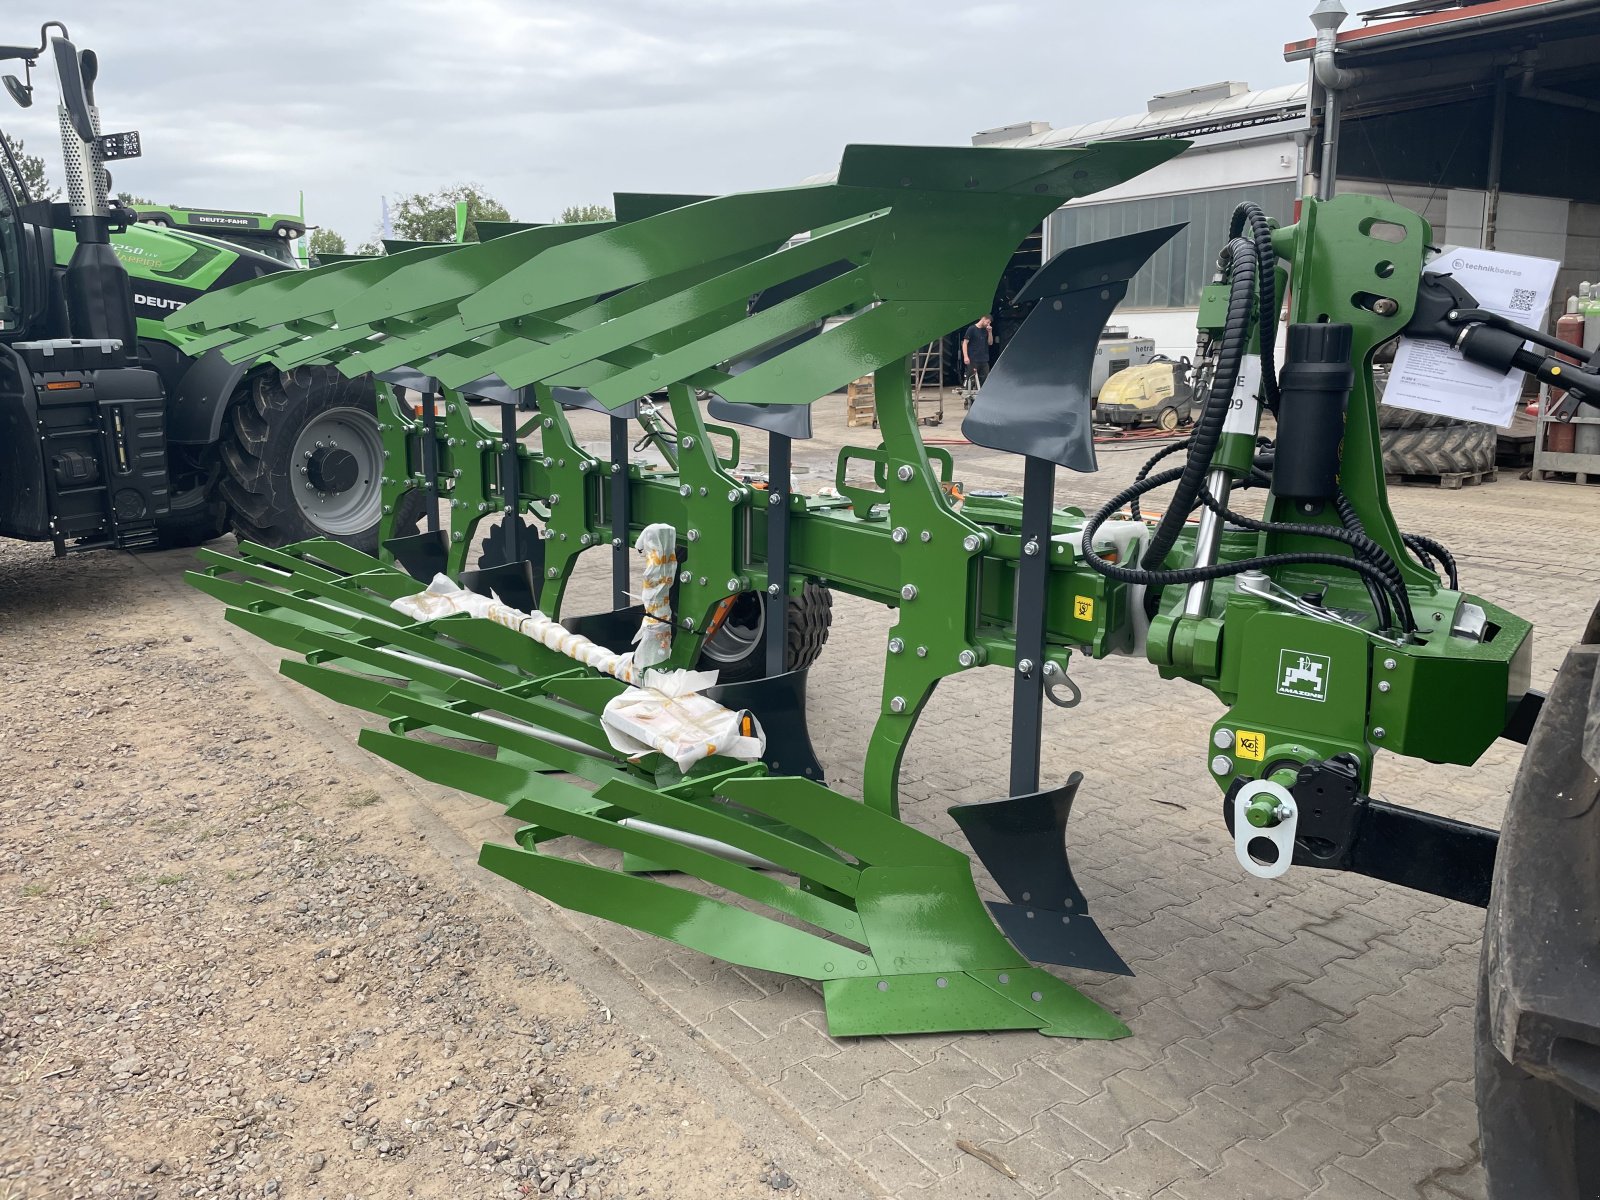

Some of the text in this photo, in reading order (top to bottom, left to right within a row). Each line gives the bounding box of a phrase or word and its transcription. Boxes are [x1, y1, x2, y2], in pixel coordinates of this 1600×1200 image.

[199, 216, 249, 225] DEUTZ-FAHR
[1135, 345, 1154, 353] hetra
[1278, 687, 1324, 699] AMAZONE
